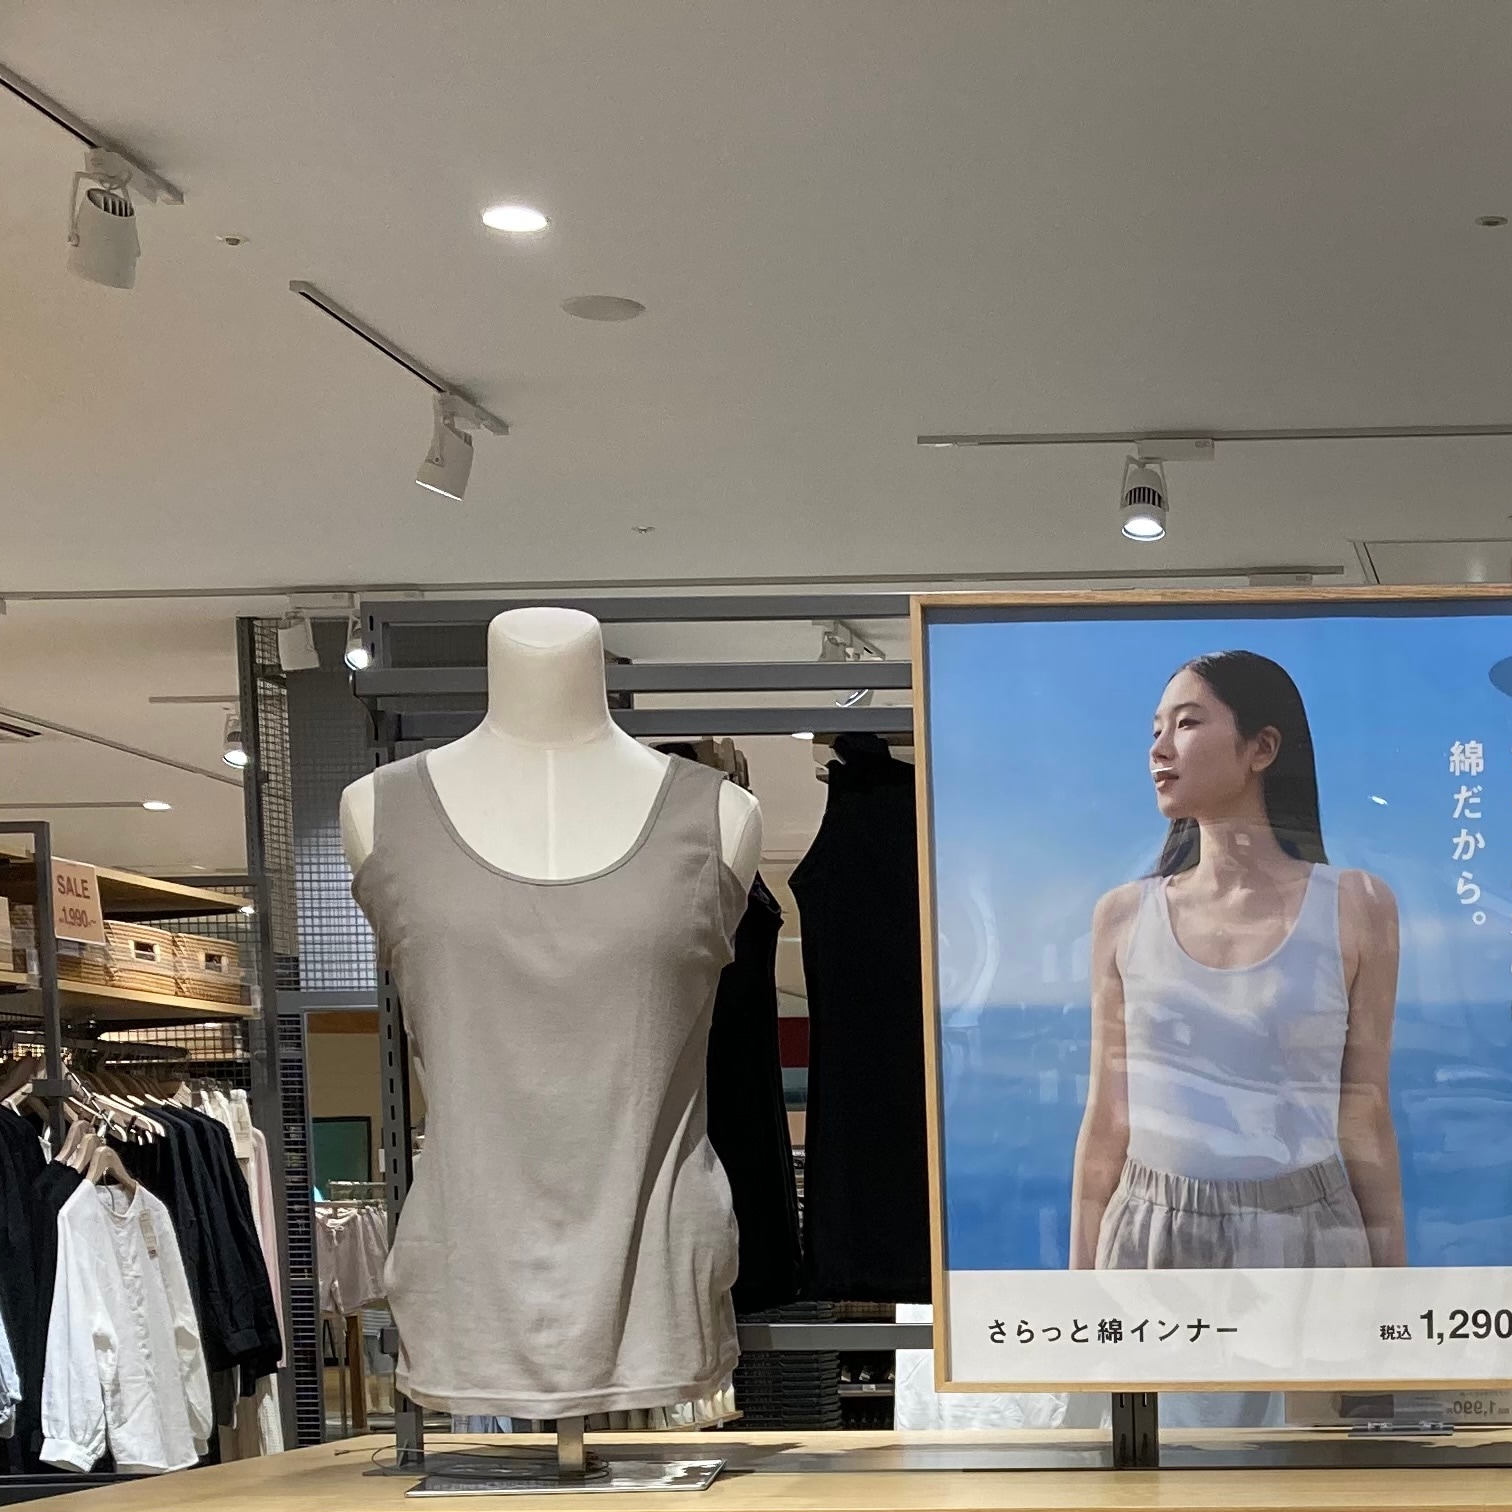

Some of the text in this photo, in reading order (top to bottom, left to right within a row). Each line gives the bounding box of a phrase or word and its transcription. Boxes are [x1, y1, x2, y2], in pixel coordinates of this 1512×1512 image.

[1449, 740, 1487, 926] 綿だから。
[57, 874, 91, 899] SALE
[987, 1317, 1239, 1344] さらっと綿インナー
[1379, 1324, 1413, 1341] 税込
